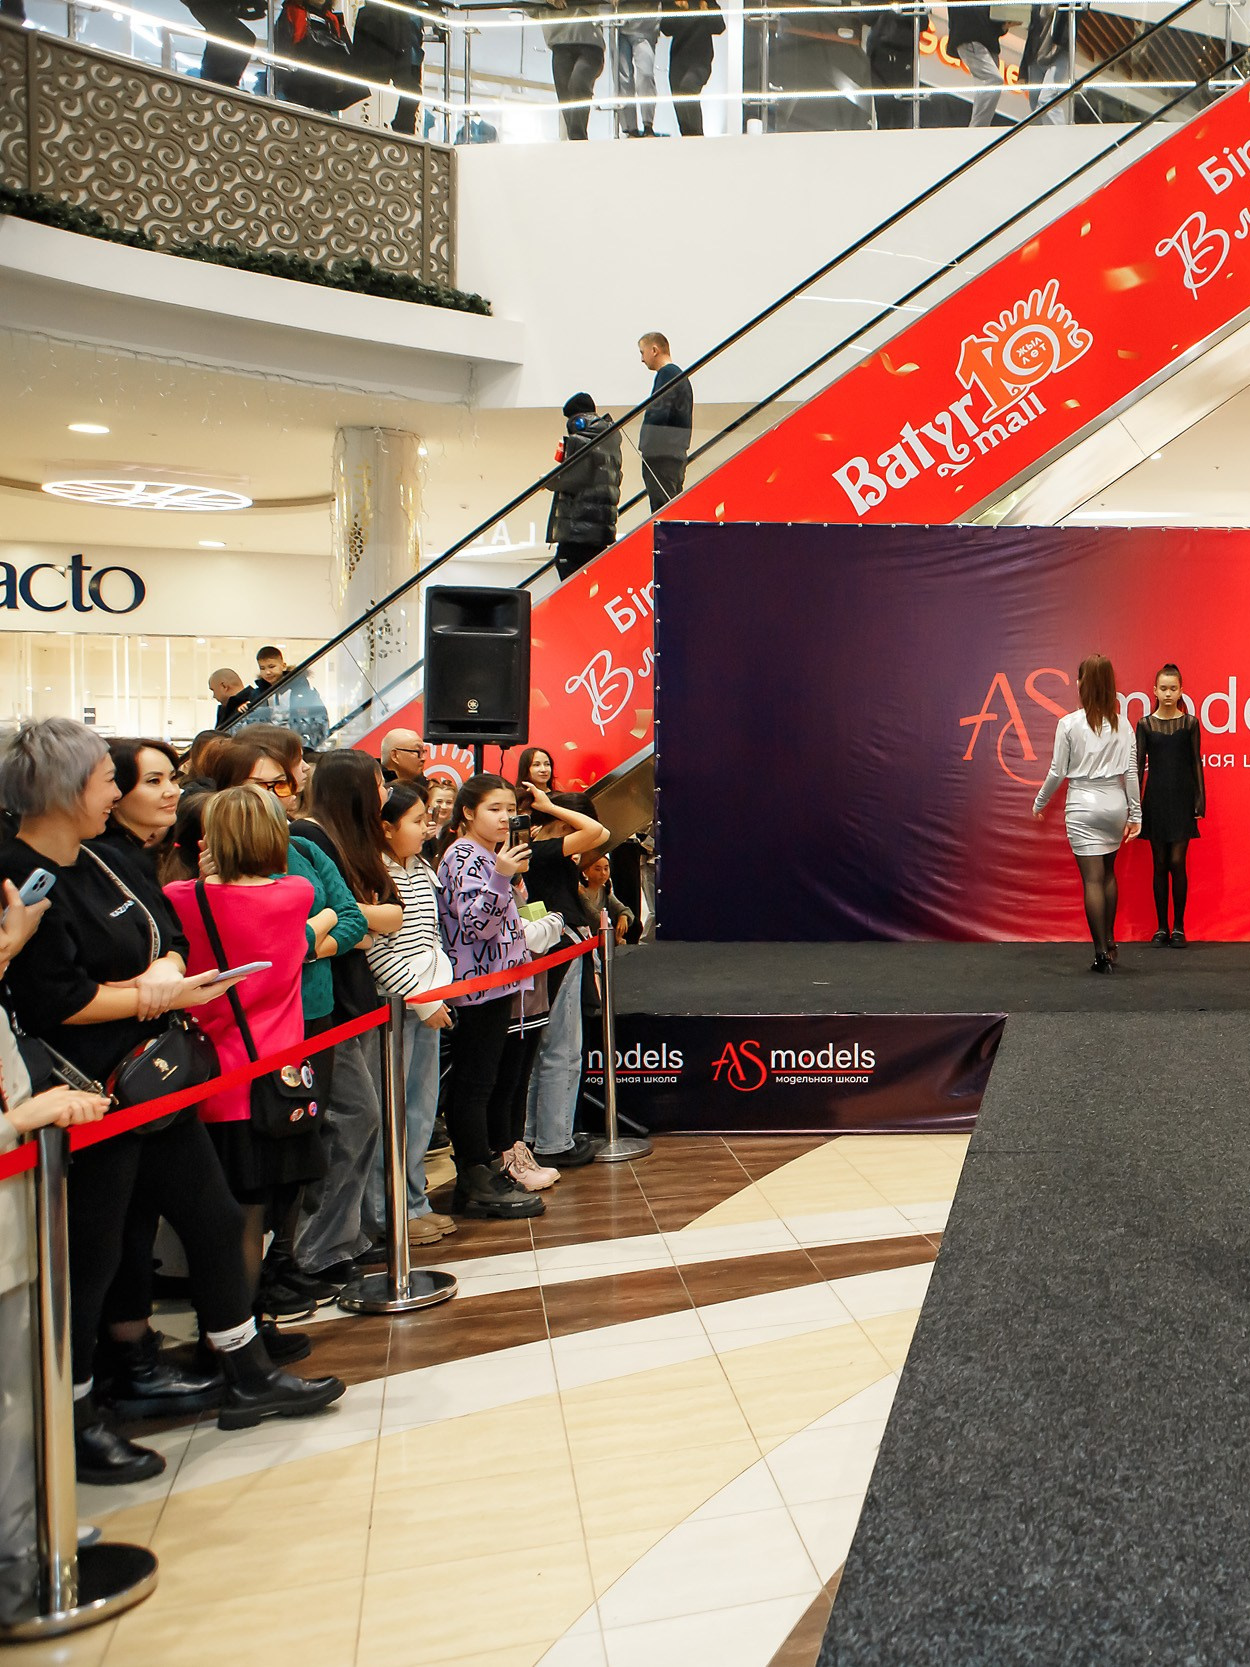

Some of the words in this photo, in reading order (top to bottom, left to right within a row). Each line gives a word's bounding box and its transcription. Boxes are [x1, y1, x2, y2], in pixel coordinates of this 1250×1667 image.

[972, 391, 1047, 455] mall
[832, 393, 980, 516] Batyr
[643, 1076, 677, 1084] школа
[711, 1040, 767, 1091] AS
[770, 1043, 876, 1069] models
[775, 1076, 831, 1085] модельная
[835, 1076, 869, 1084] школа
